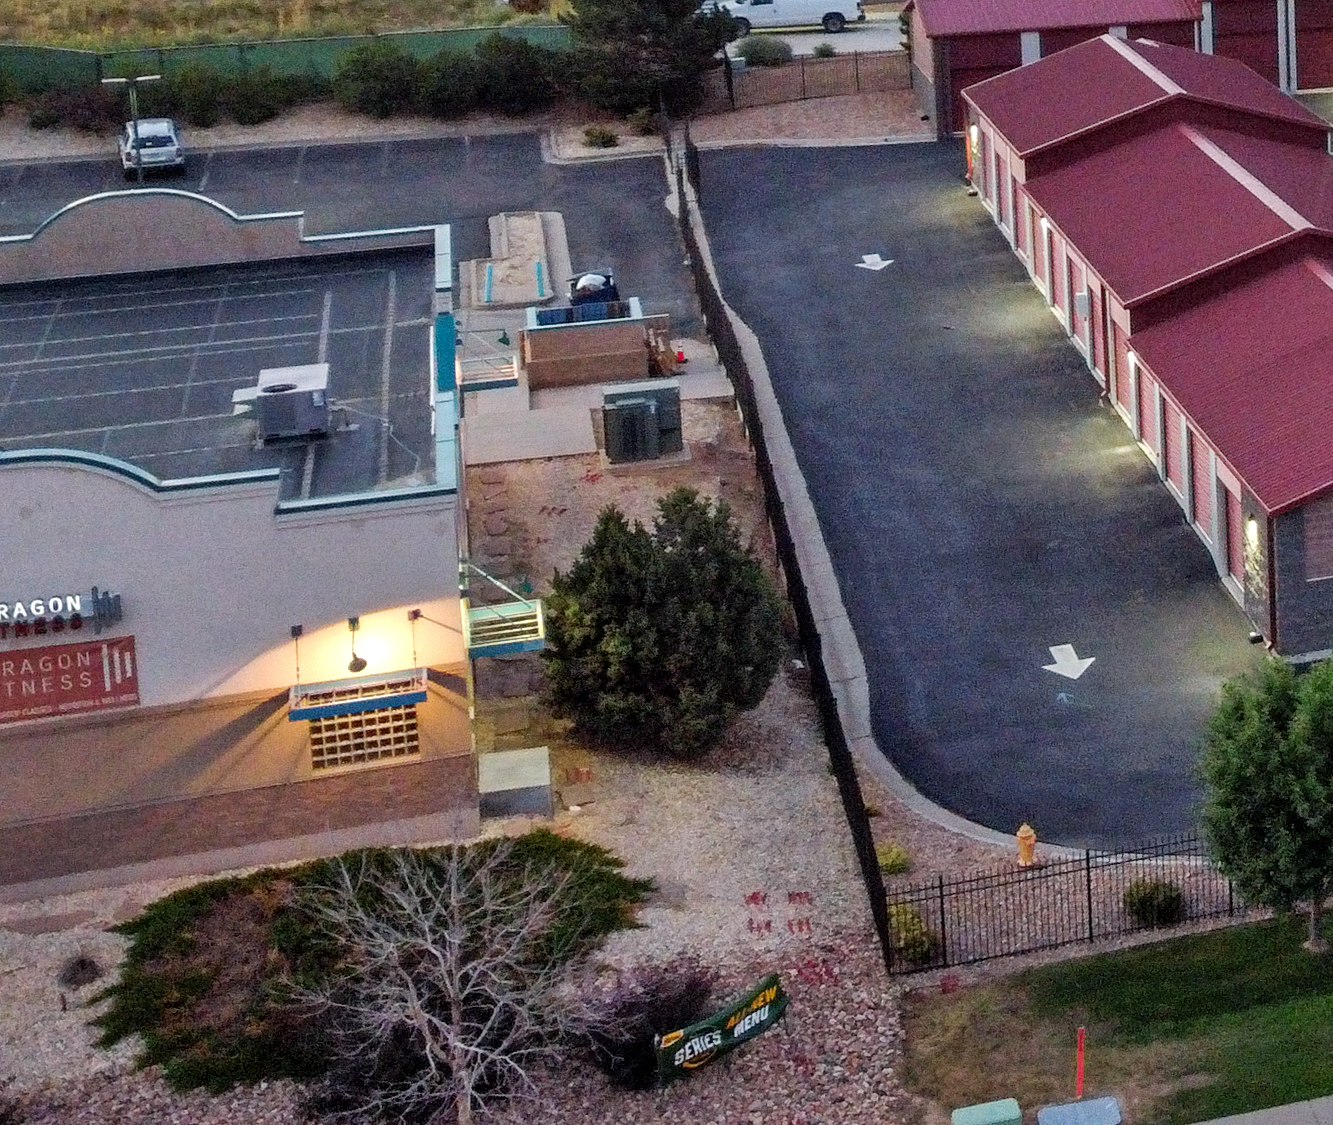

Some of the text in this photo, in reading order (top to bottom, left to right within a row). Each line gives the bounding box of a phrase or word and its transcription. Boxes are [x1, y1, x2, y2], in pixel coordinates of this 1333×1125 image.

[0, 595, 81, 619] RAGON
[2, 652, 90, 676] RAGON
[4, 672, 92, 696] TNESS
[734, 1004, 769, 1037] MENU
[674, 1030, 721, 1066] SERIES
